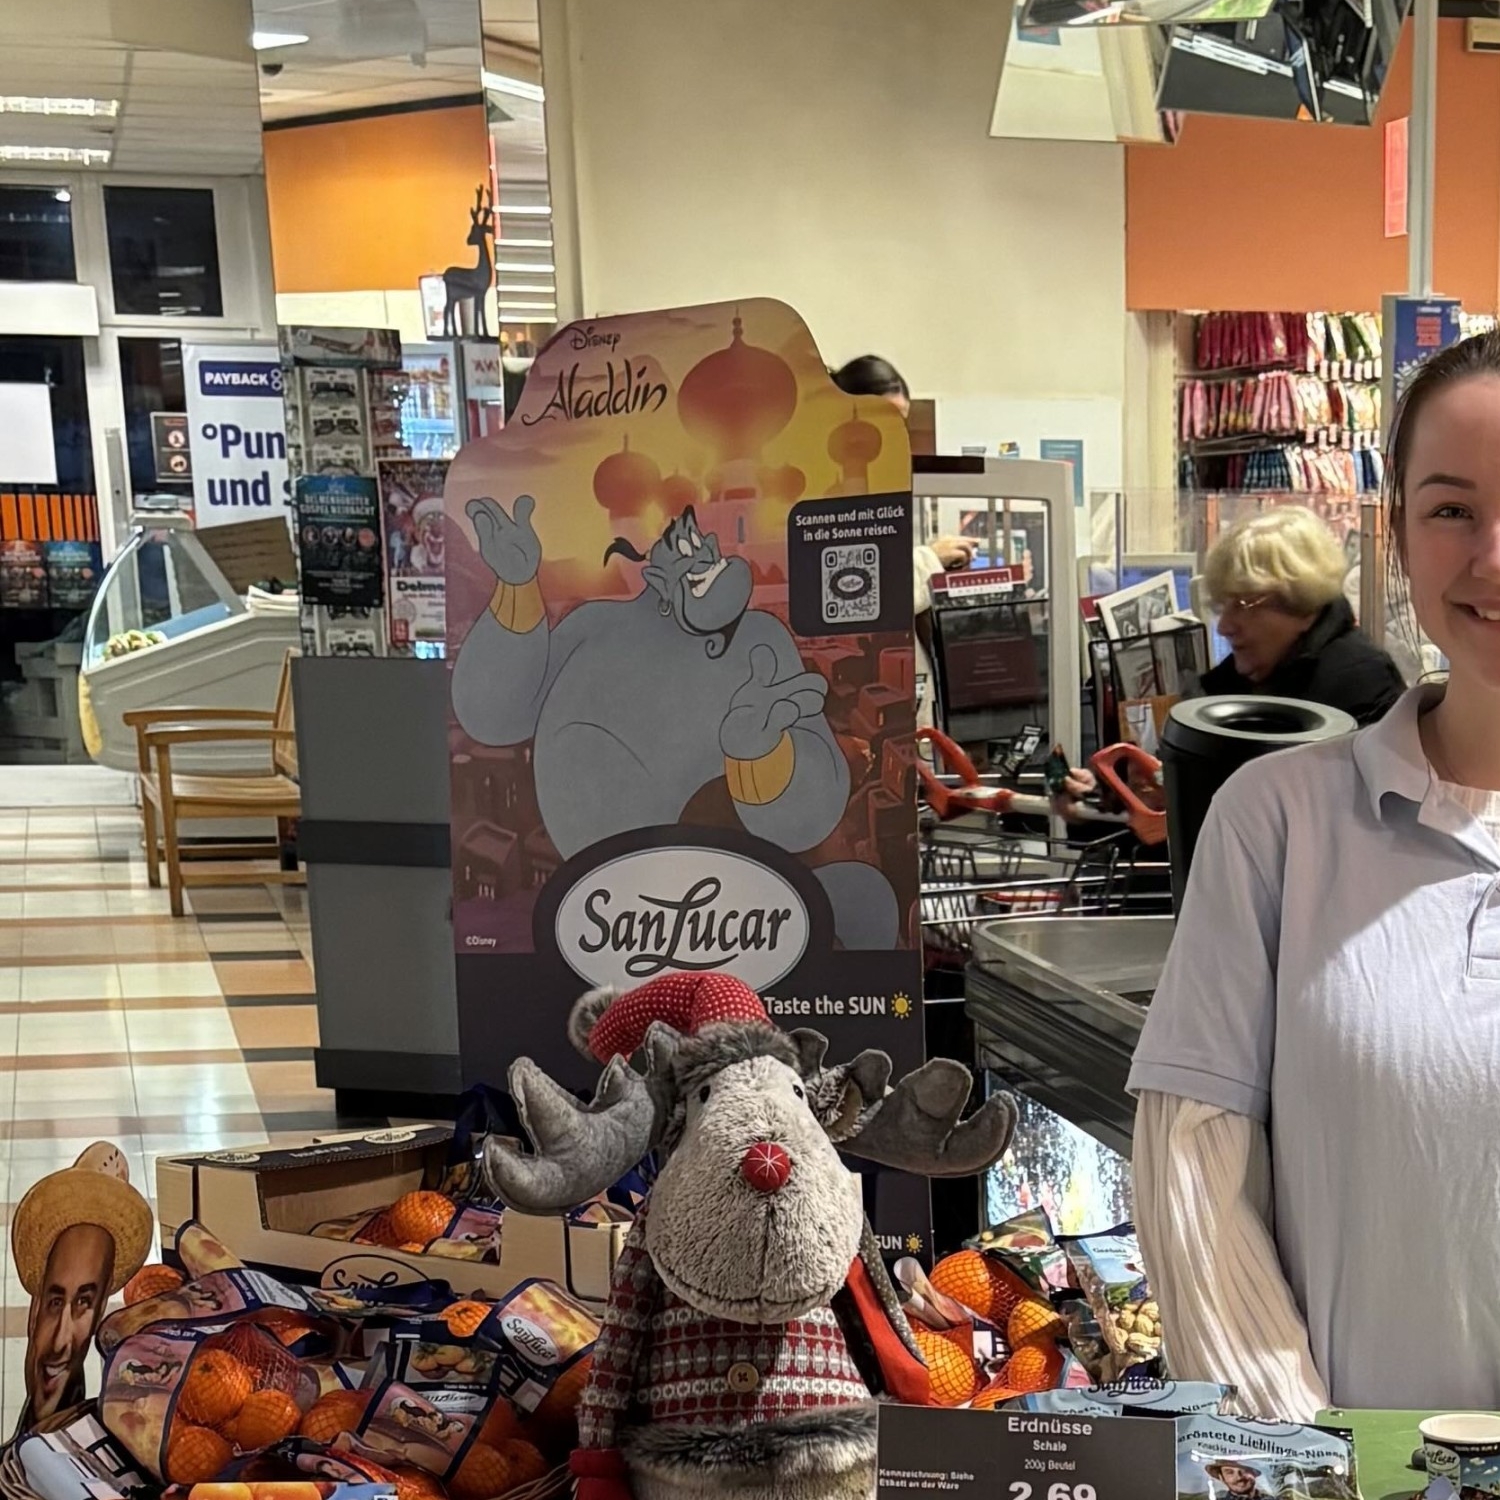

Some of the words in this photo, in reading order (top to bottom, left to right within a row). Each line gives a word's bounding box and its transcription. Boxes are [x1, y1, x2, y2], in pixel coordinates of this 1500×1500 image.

[568, 326, 621, 352] Disney
[204, 372, 269, 386] PAYBACK
[521, 358, 667, 426] Aladdin
[207, 471, 271, 506] und
[796, 514, 835, 526] Scannen
[838, 510, 856, 522] und
[858, 508, 874, 520] mit
[877, 505, 905, 519] Glück
[803, 530, 813, 541] in
[815, 528, 829, 540] die
[832, 527, 862, 539] Sonne
[864, 524, 897, 537] reisen.
[578, 876, 791, 977] SanLucar
[764, 996, 810, 1015] Taste
[814, 995, 845, 1015] the
[848, 996, 886, 1015] SUN
[873, 1235, 902, 1250] SUN
[506, 1317, 556, 1361] SanLucar
[1008, 1417, 1092, 1436] Erdnüsse
[1033, 1440, 1067, 1452] Schale
[1024, 1459, 1045, 1471] 200g
[1048, 1460, 1076, 1471] Beutel
[937, 1481, 960, 1490] Ware
